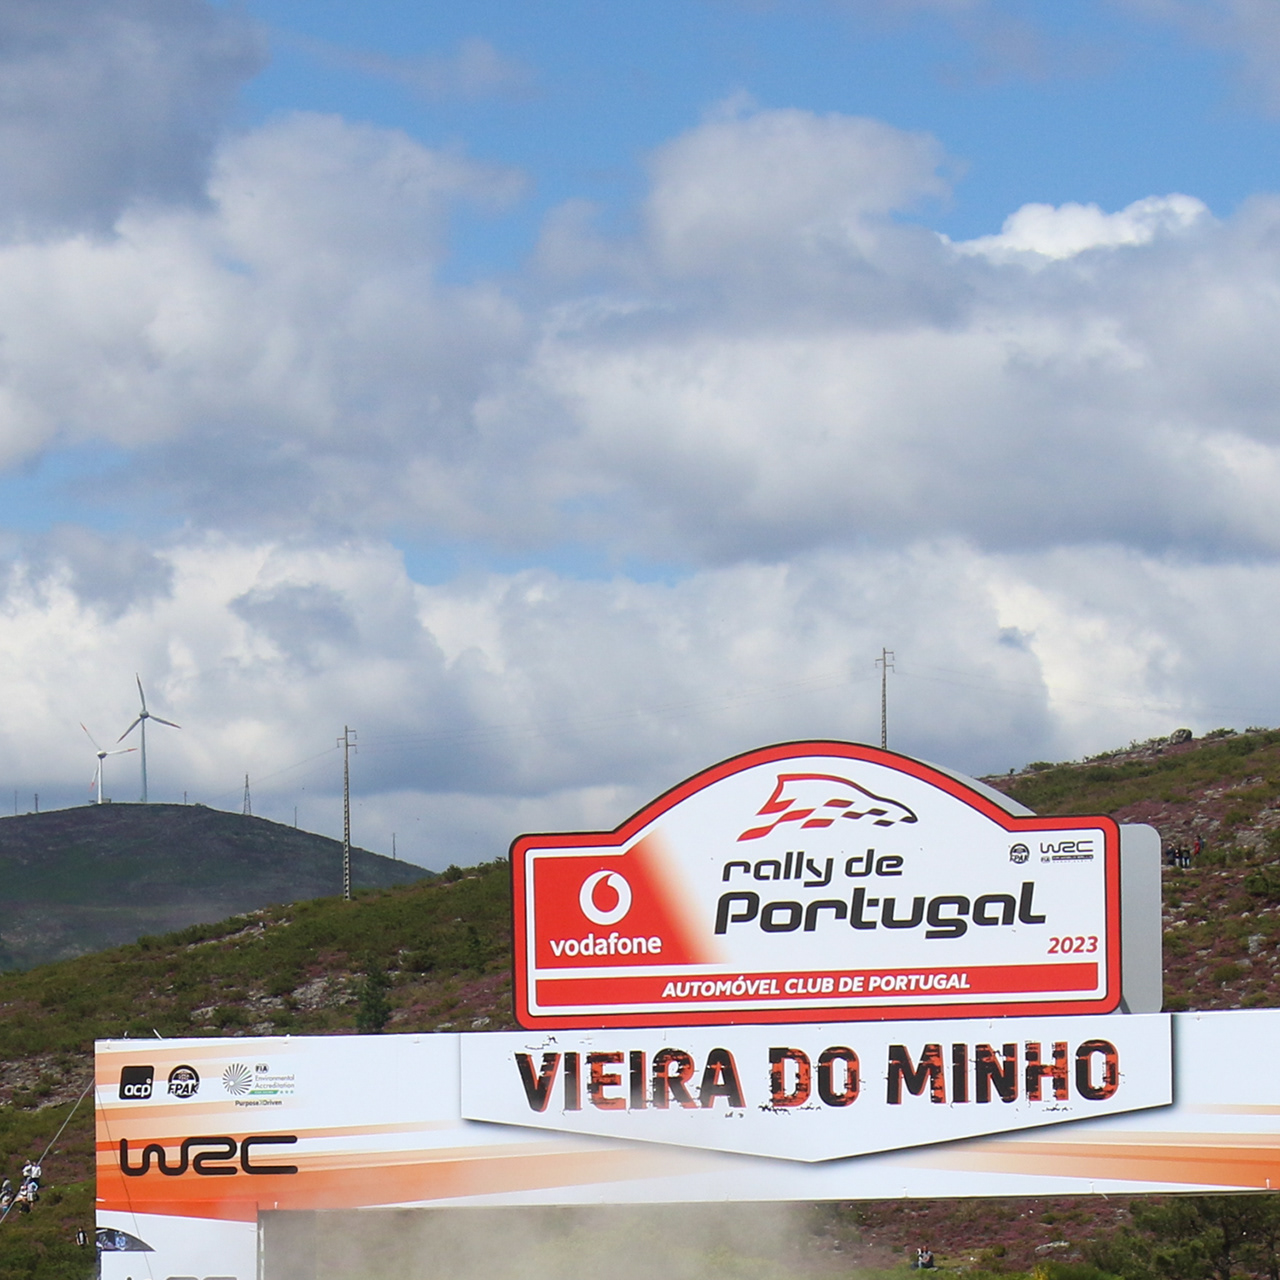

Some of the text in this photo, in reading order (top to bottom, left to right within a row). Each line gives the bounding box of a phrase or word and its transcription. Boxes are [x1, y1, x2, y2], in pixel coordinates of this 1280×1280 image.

[722, 848, 903, 887] rally de
[714, 882, 1047, 940] Portugal
[550, 932, 663, 957] vodafone
[1047, 934, 1099, 955] 2023
[662, 973, 971, 998] AUTOMÓVEL CLUB DE PORTUGAL
[515, 1039, 1121, 1113] VIEIRA DO MINHO
[123, 1083, 151, 1098] acp
[167, 1083, 200, 1095] FPAK
[120, 1135, 299, 1177] WRC
